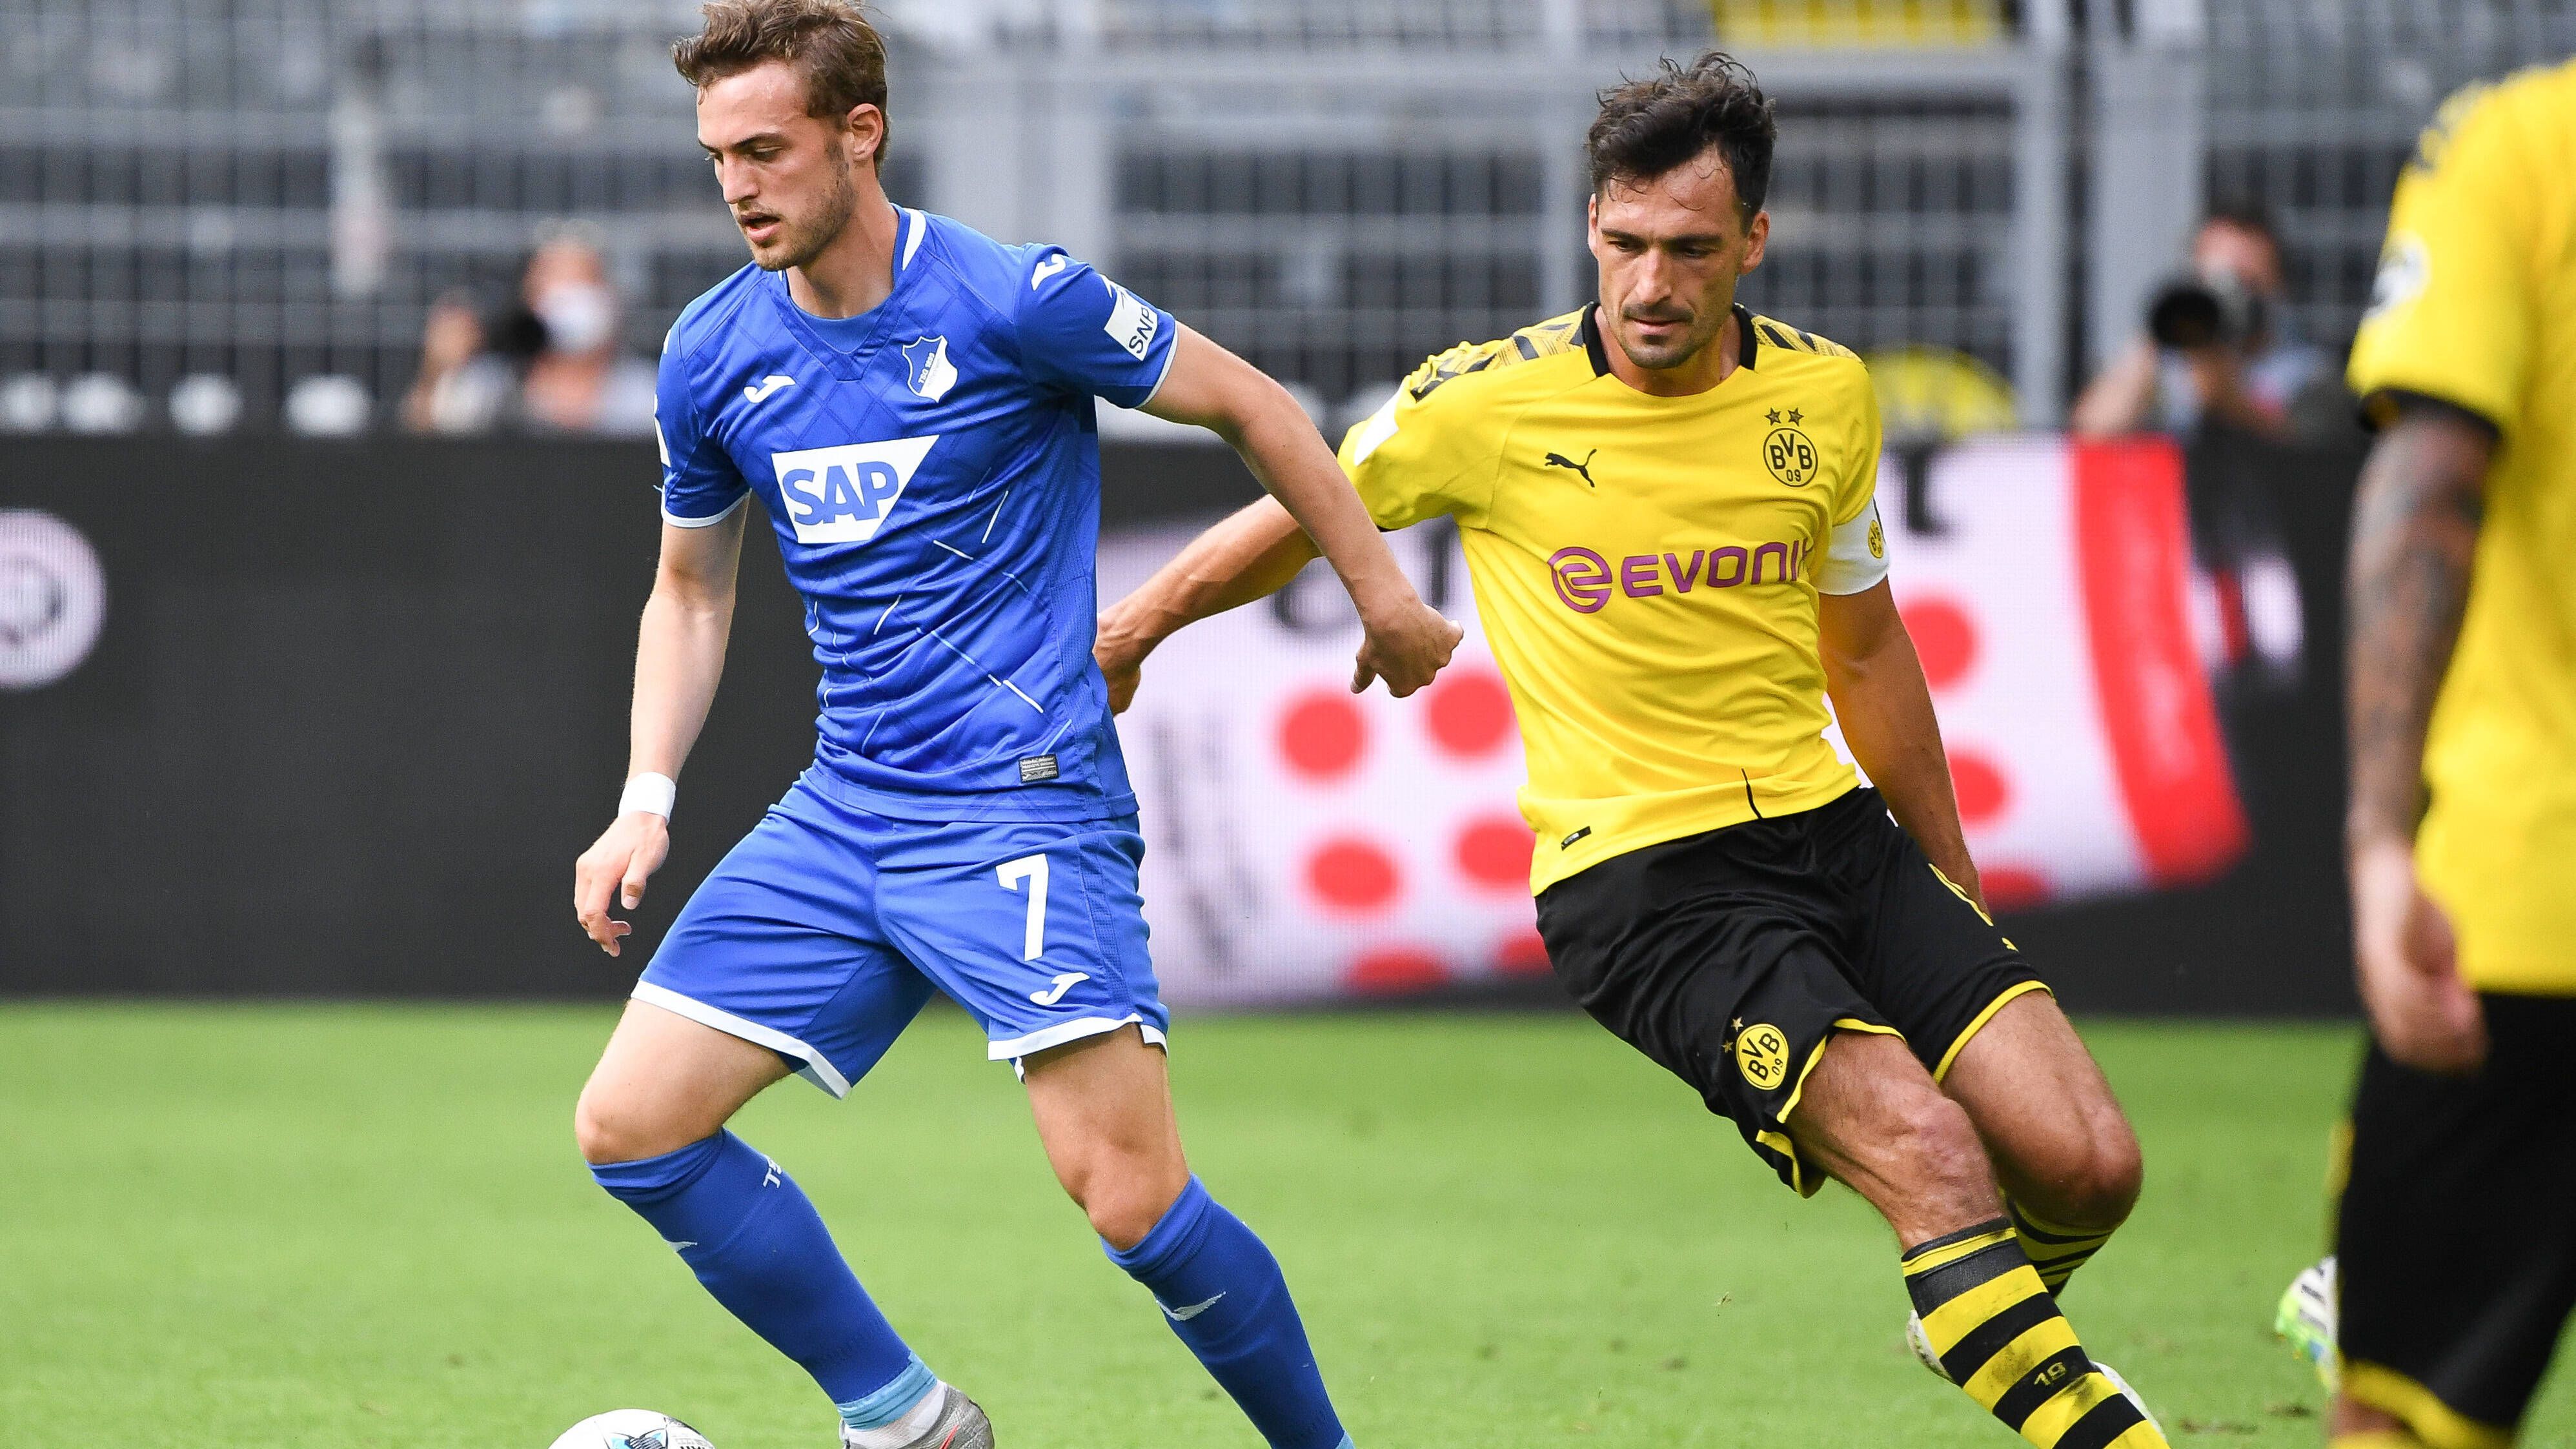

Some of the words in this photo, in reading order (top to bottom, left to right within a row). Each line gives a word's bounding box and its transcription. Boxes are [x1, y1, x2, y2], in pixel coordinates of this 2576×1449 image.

[1128, 307, 1154, 354] SNP
[1769, 433, 1813, 470] BVB
[782, 461, 899, 526] SAP
[1786, 469, 1801, 482] 09
[1621, 538, 1808, 598] EVONI
[995, 853, 1050, 962] 7
[1741, 1033, 1780, 1081] BVB
[1771, 1058, 1784, 1076] 09
